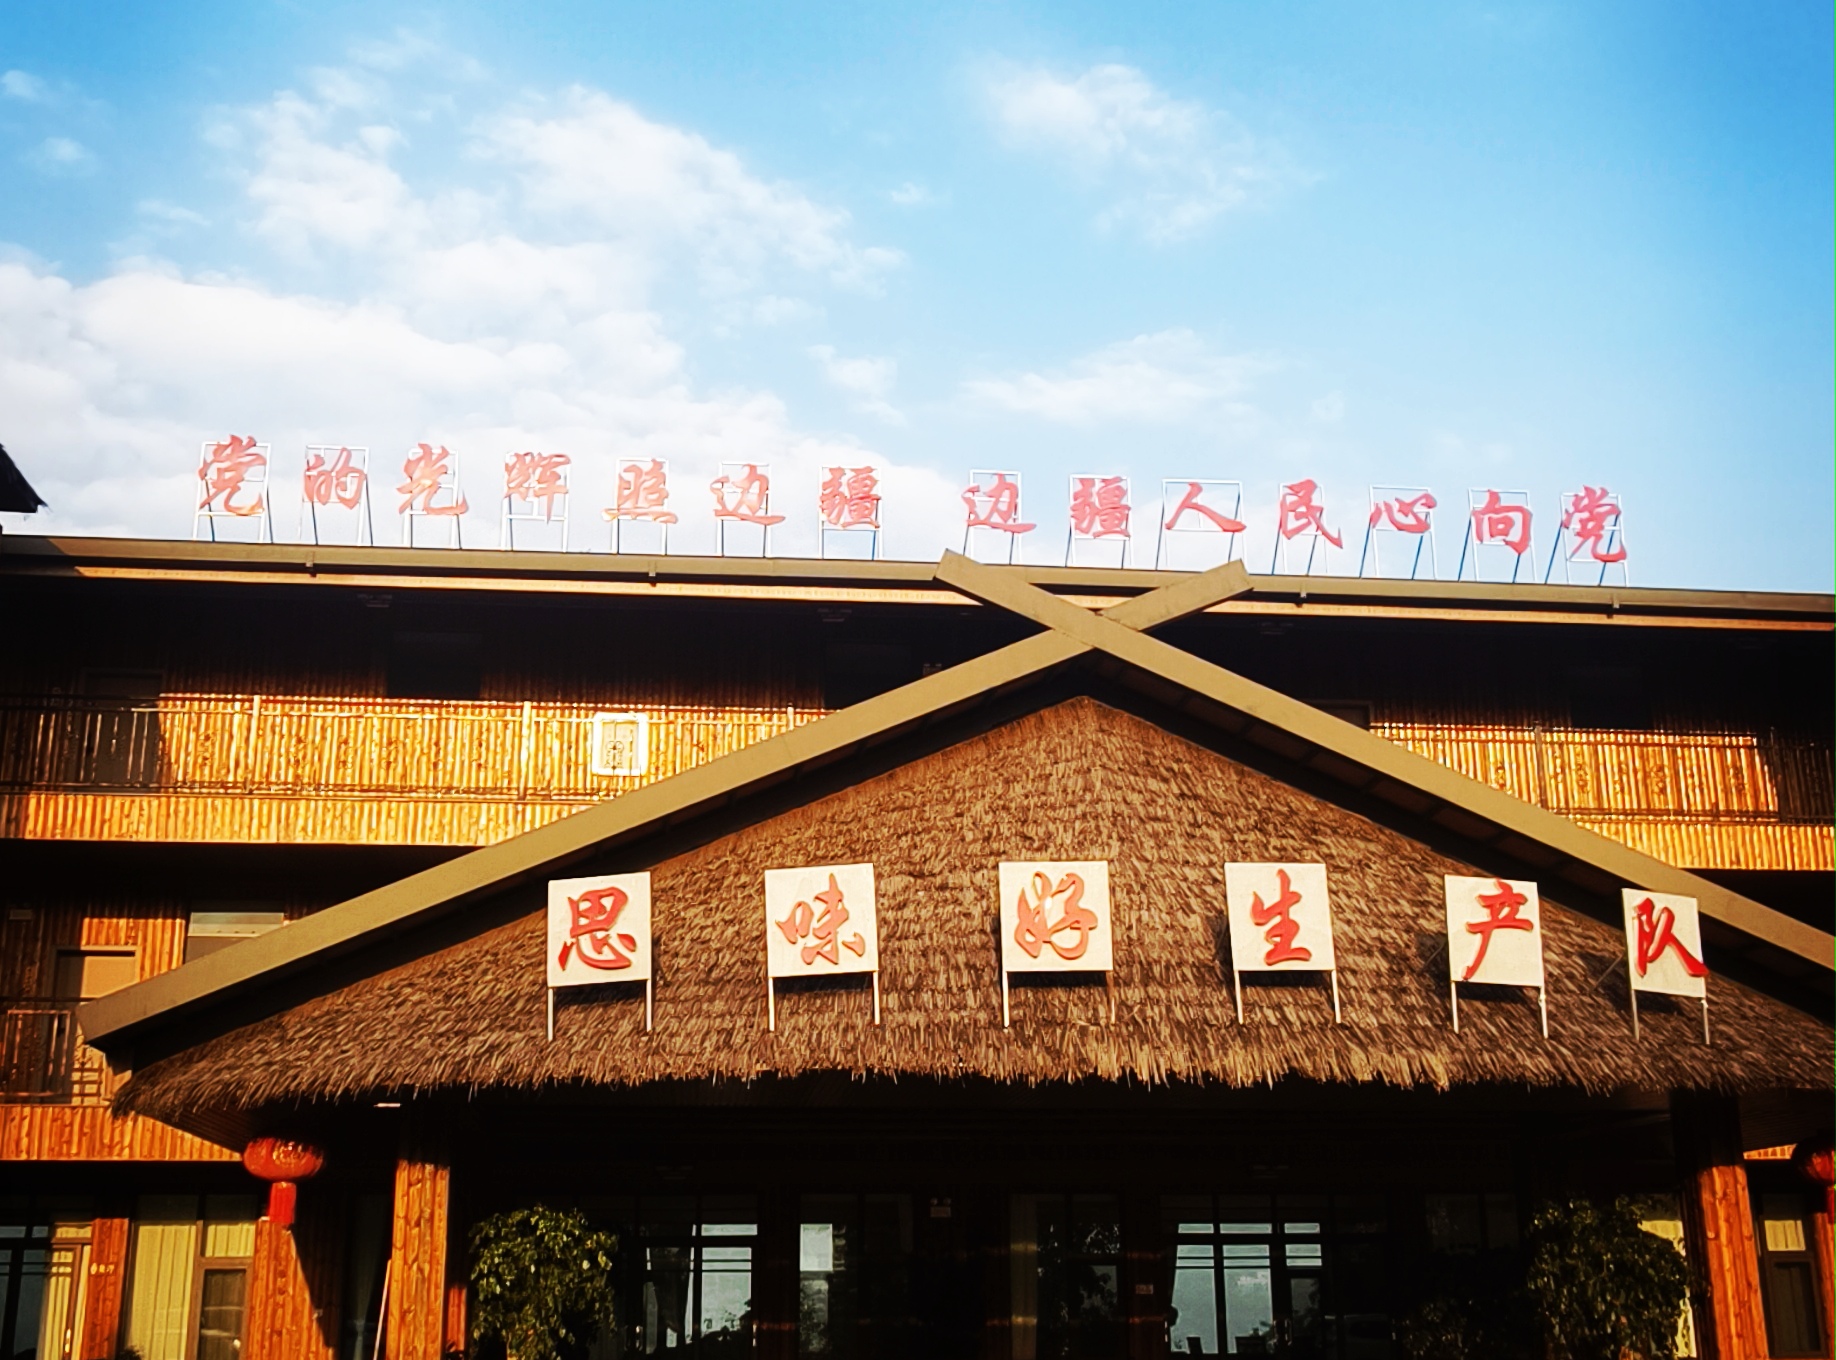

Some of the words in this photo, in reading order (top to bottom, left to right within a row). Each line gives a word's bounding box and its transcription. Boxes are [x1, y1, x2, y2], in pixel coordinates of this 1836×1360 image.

[198, 434, 880, 528] 党的光辉照边疆
[963, 472, 1627, 563] 边疆人民心向党
[557, 868, 1710, 981] 思味好生产队
